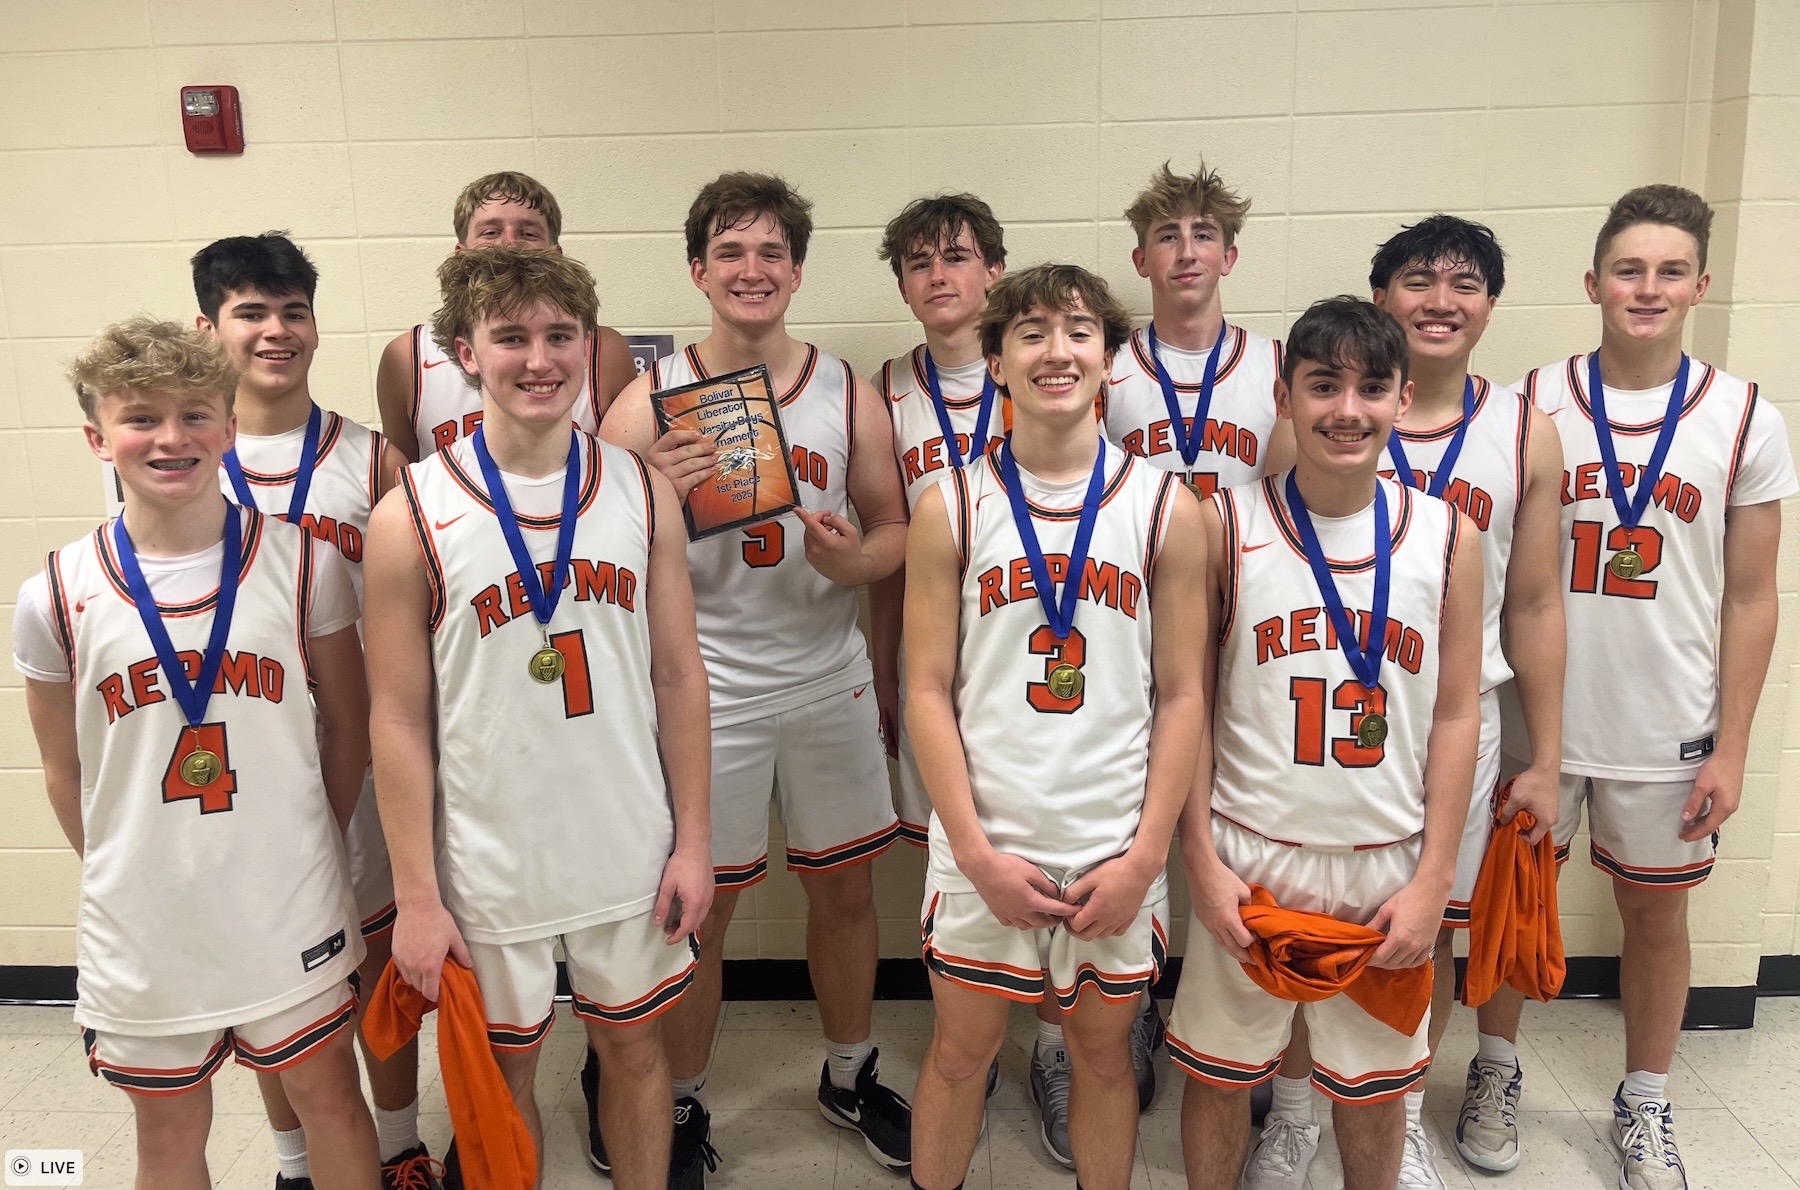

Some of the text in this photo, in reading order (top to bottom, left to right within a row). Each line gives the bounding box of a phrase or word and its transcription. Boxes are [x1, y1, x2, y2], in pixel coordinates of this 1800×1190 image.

[697, 402, 744, 421] Liberator
[699, 389, 734, 403] Bolivar
[699, 413, 764, 436] Varsity Boys
[716, 474, 761, 494] 1st Place
[731, 490, 753, 502] 2025
[1569, 520, 1664, 600] 12
[978, 553, 1142, 622] REPMO
[549, 628, 595, 719] 1
[1026, 624, 1087, 715] 3
[1289, 675, 1388, 769] 13
[161, 721, 238, 816] 4
[333, 938, 342, 950] M
